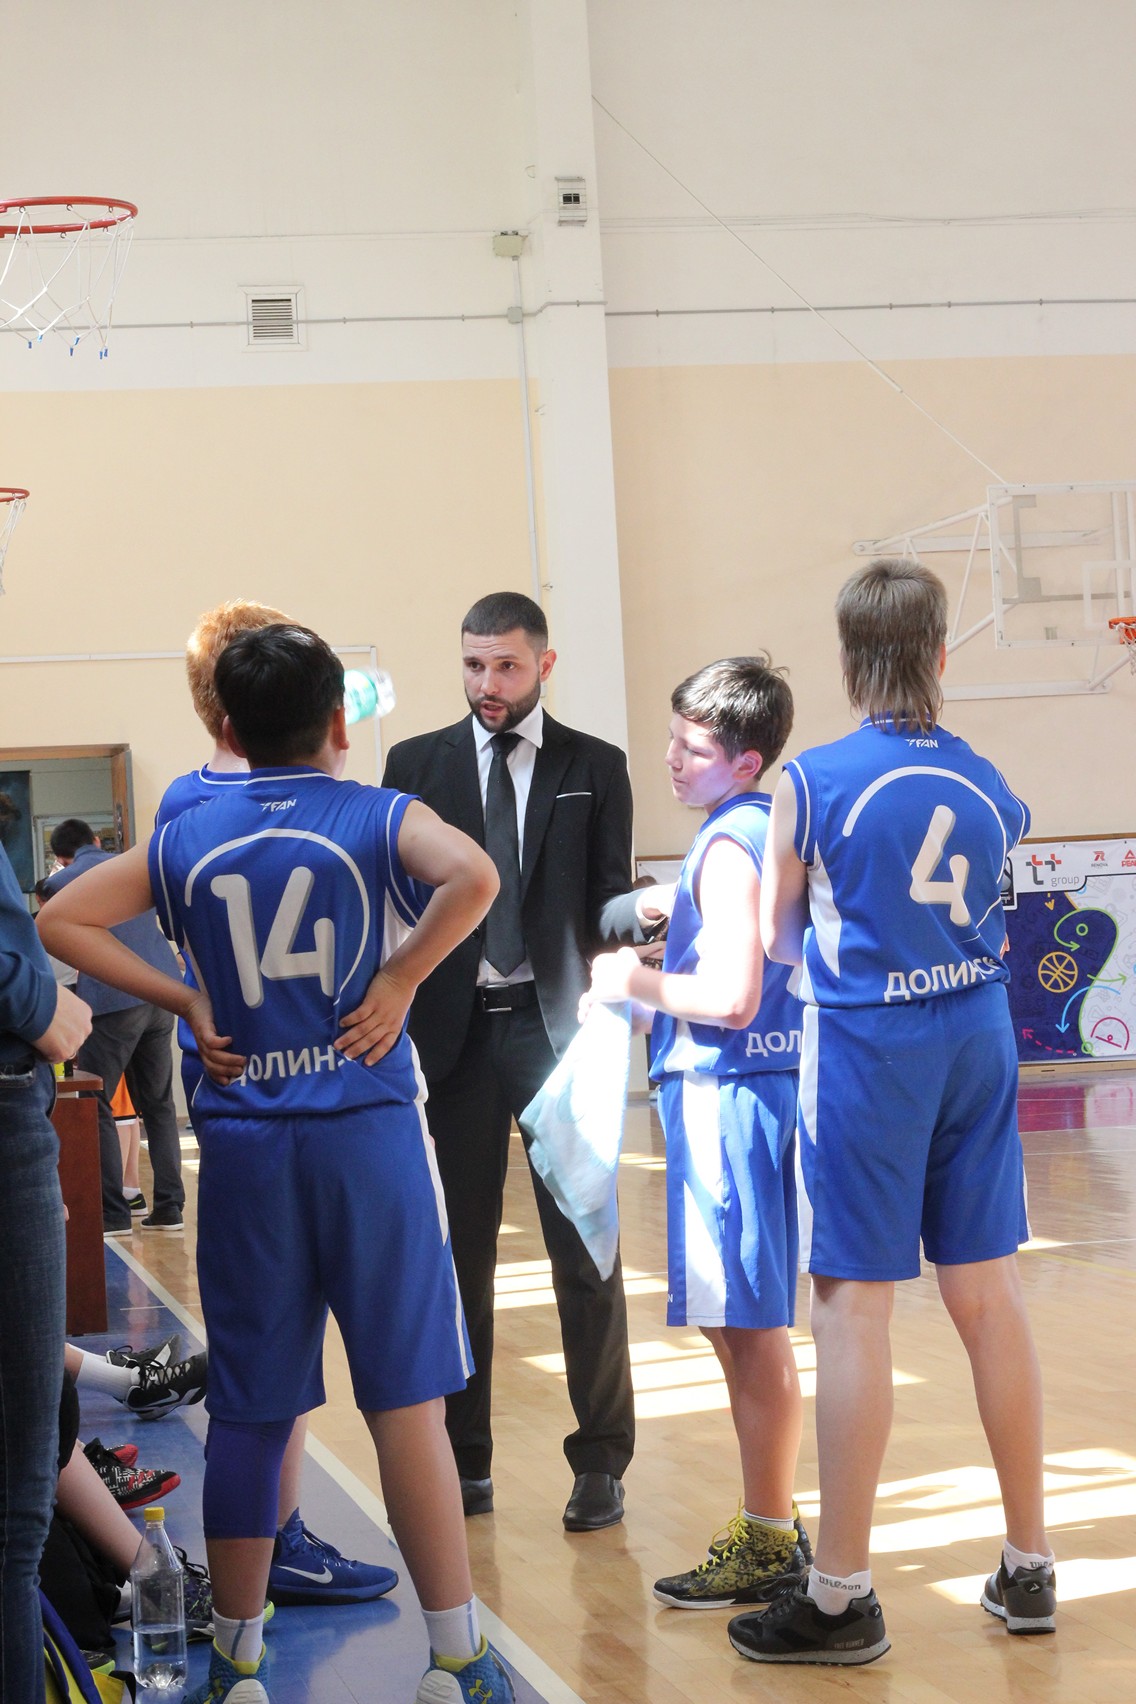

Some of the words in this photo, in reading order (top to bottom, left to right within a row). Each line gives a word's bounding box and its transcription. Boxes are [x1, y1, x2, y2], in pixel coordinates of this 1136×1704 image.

[909, 805, 970, 926] 4
[1051, 875, 1080, 887] group
[210, 866, 336, 1009] 14
[818, 1575, 862, 1590] Wilson
